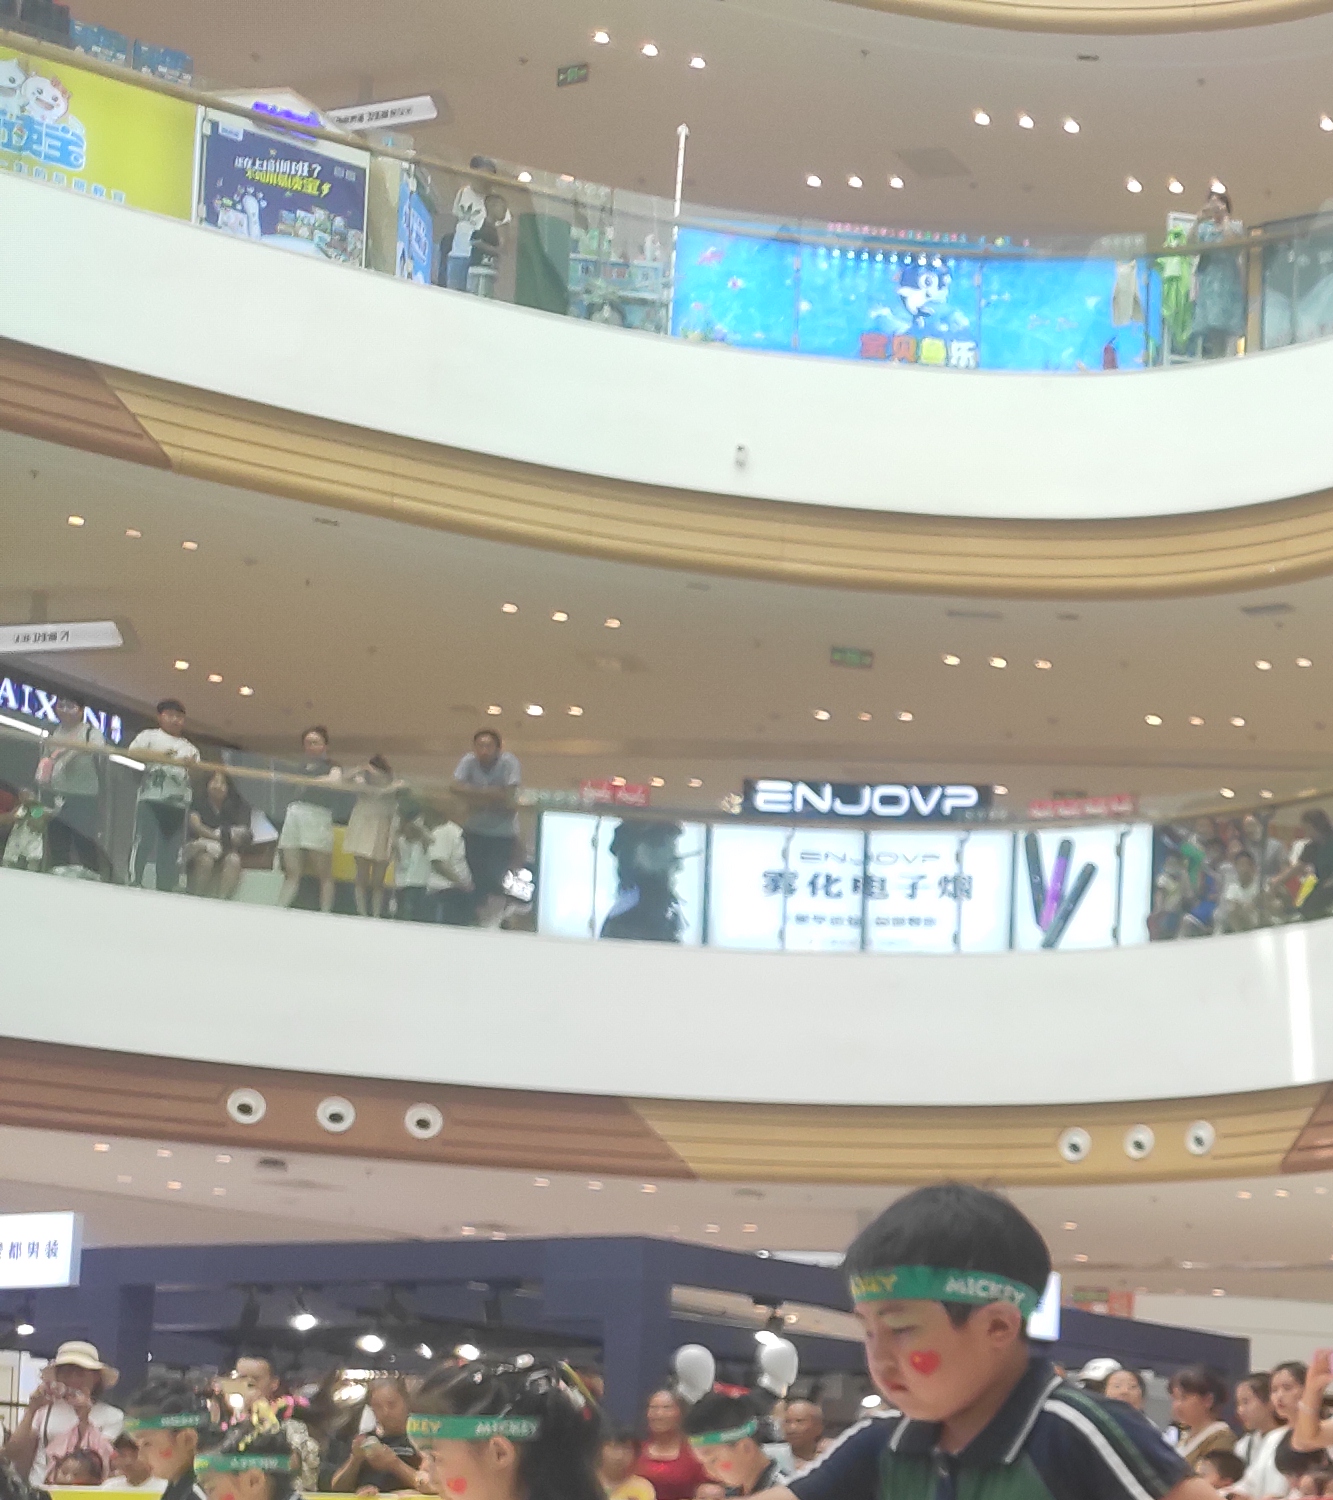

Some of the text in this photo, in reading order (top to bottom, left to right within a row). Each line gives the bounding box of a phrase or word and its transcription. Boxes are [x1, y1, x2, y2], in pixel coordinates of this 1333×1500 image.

[754, 780, 980, 816] ENJOVP
[762, 870, 973, 901] 雾化电子烟
